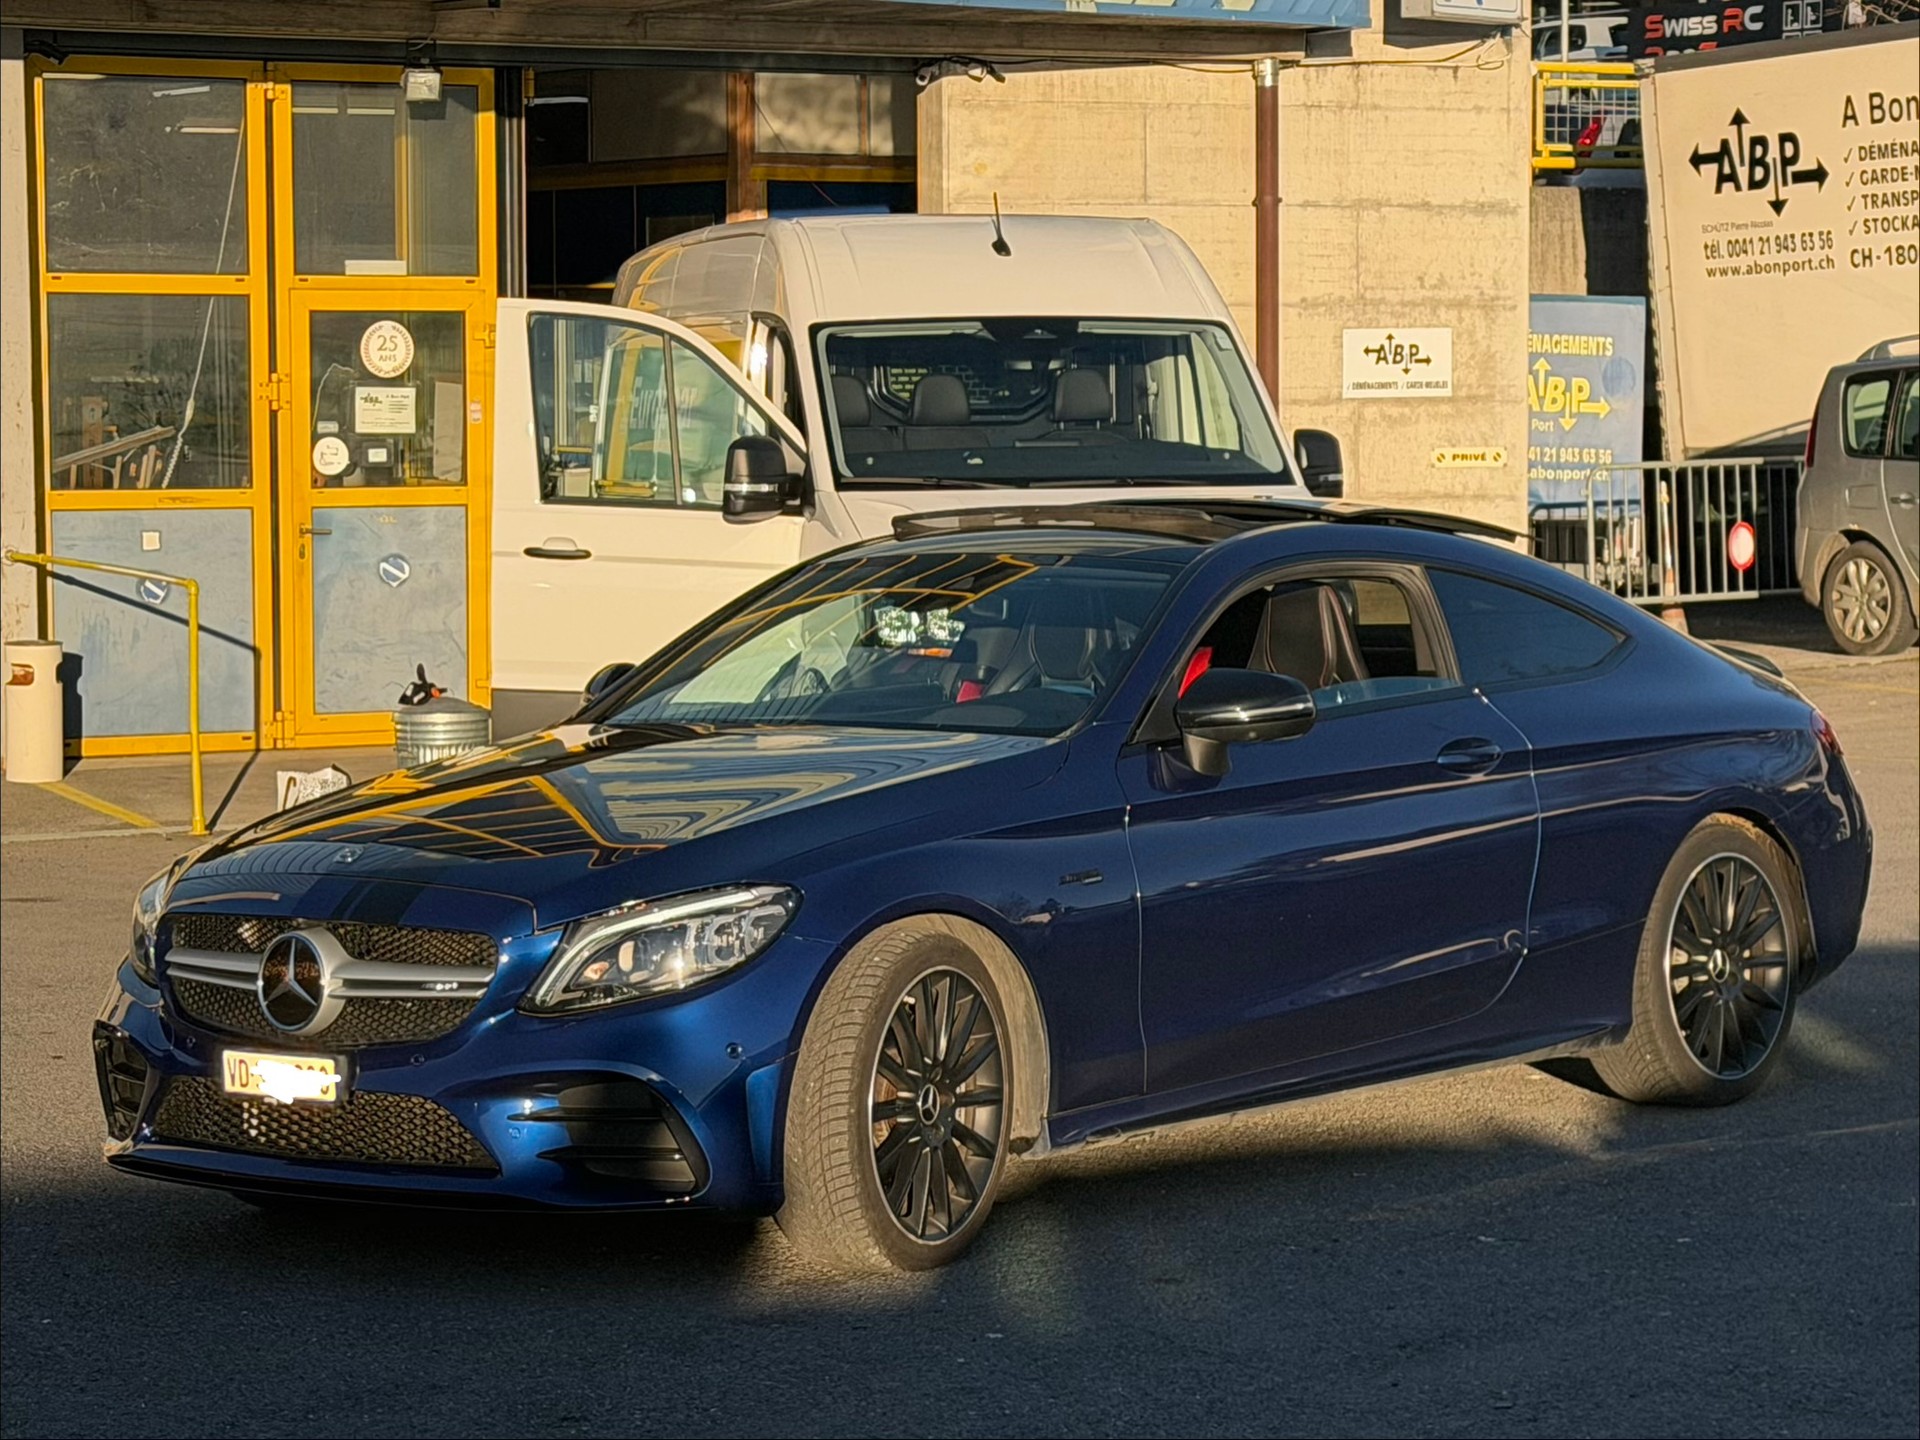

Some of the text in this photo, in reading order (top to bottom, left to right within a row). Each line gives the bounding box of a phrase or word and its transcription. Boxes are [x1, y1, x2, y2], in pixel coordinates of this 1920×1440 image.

[1644, 5, 1764, 39] SWISS RC
[1841, 92, 1919, 128] A Bon
[1858, 138, 1919, 162] DÉMÉNA
[1714, 132, 1801, 194] ABP
[1861, 190, 1919, 210] TRANSP
[1863, 214, 1919, 235] STOCKA
[1703, 230, 1834, 260] tél. 0041 21 943 63 56
[1705, 254, 1835, 278] www.abonport.ch
[377, 335, 398, 352] 25
[1375, 343, 1420, 365] ABP
[1531, 418, 1554, 431] Port
[1452, 451, 1487, 462] PRIVÉ
[1543, 446, 1556, 462] 21
[1560, 447, 1580, 464] 943
[1583, 448, 1597, 464] 63
[1599, 449, 1613, 465] 56
[227, 1057, 249, 1088] VD
